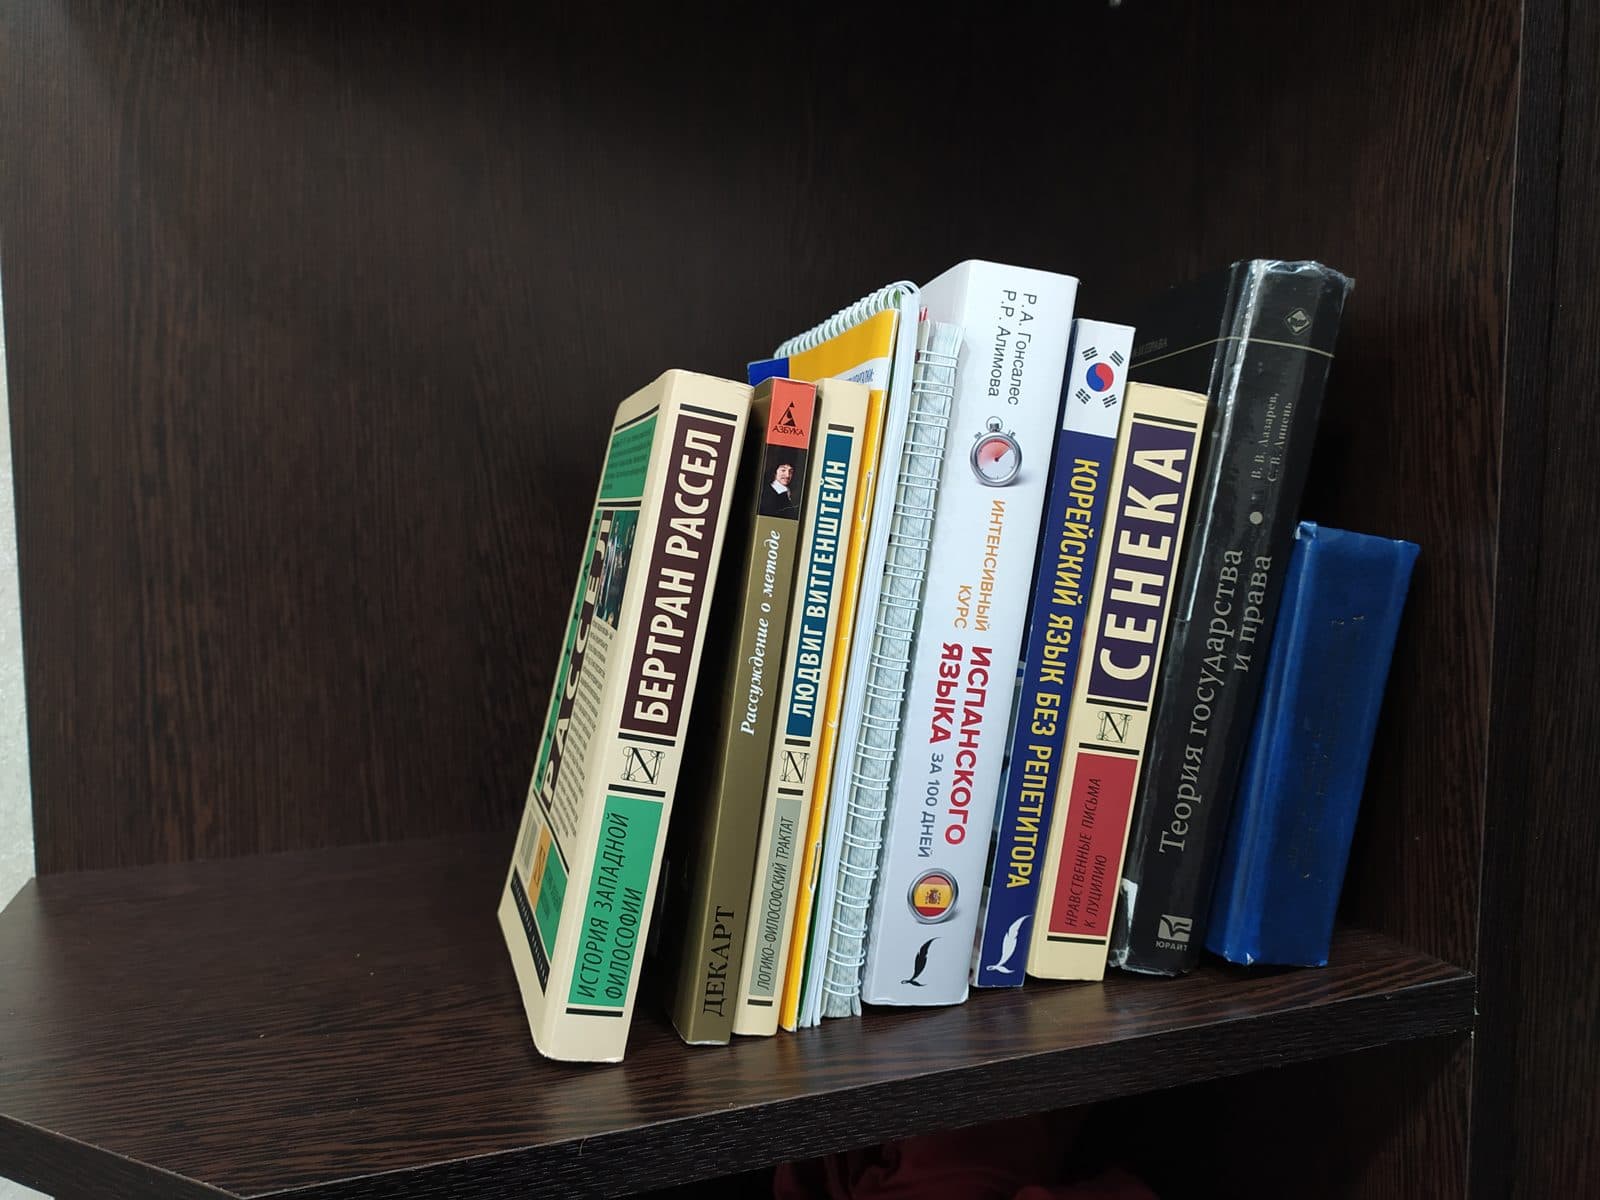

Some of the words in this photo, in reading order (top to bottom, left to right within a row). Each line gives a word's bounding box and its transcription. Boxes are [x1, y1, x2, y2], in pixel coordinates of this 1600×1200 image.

[988, 326, 1011, 397] Алимова
[1007, 331, 1031, 406] Гонсалес
[772, 425, 805, 437] АЗБУКА
[634, 568, 695, 725] БЕРТРАН
[666, 428, 721, 561] РАССЕЛ
[762, 530, 782, 598] методе
[806, 460, 847, 618] ВИТГЕНШТЕЙН
[975, 499, 1006, 632] ИНТЕНСИВНЫЙ
[1052, 458, 1100, 606] КОРЕЙСКИЙ
[1099, 448, 1188, 682] СЕНЕКА
[760, 602, 772, 613] о
[954, 584, 972, 629] КУРС
[1240, 555, 1272, 643] права
[739, 617, 770, 736] Рассуждение
[792, 624, 825, 718] ЛЮДВИГ
[929, 642, 964, 744] ЯЗЫКА
[1039, 613, 1073, 685] ЯЗЫК
[1233, 652, 1251, 672] и
[944, 645, 993, 846] ИСПАНСКОГО
[1031, 692, 1060, 737] БЕЗ
[1159, 744, 1204, 854] Теория
[1189, 549, 1243, 736] государства
[925, 779, 941, 807] 100
[929, 753, 944, 774] ЗА
[918, 811, 936, 858] ДНЕЙ
[1007, 744, 1053, 889] РЕПЕТИТОРА
[1065, 833, 1092, 928] НРАВСТВЕННЫЕ
[1082, 778, 1102, 829] ПИСЬМА
[577, 916, 610, 998] ИСТОРИЯ
[595, 812, 630, 911] ЗАПАДНОЙ
[757, 863, 788, 990] ЛОГИКО-ФИЛОСОФСКИЙ
[776, 816, 794, 861] ТРАКТАТ
[1084, 918, 1096, 929] К
[1086, 854, 1108, 915] ЛУЦИЛИЮ
[604, 887, 644, 1000] ФИЛОСОФИИ
[703, 905, 735, 1017] ДЕКАРТ
